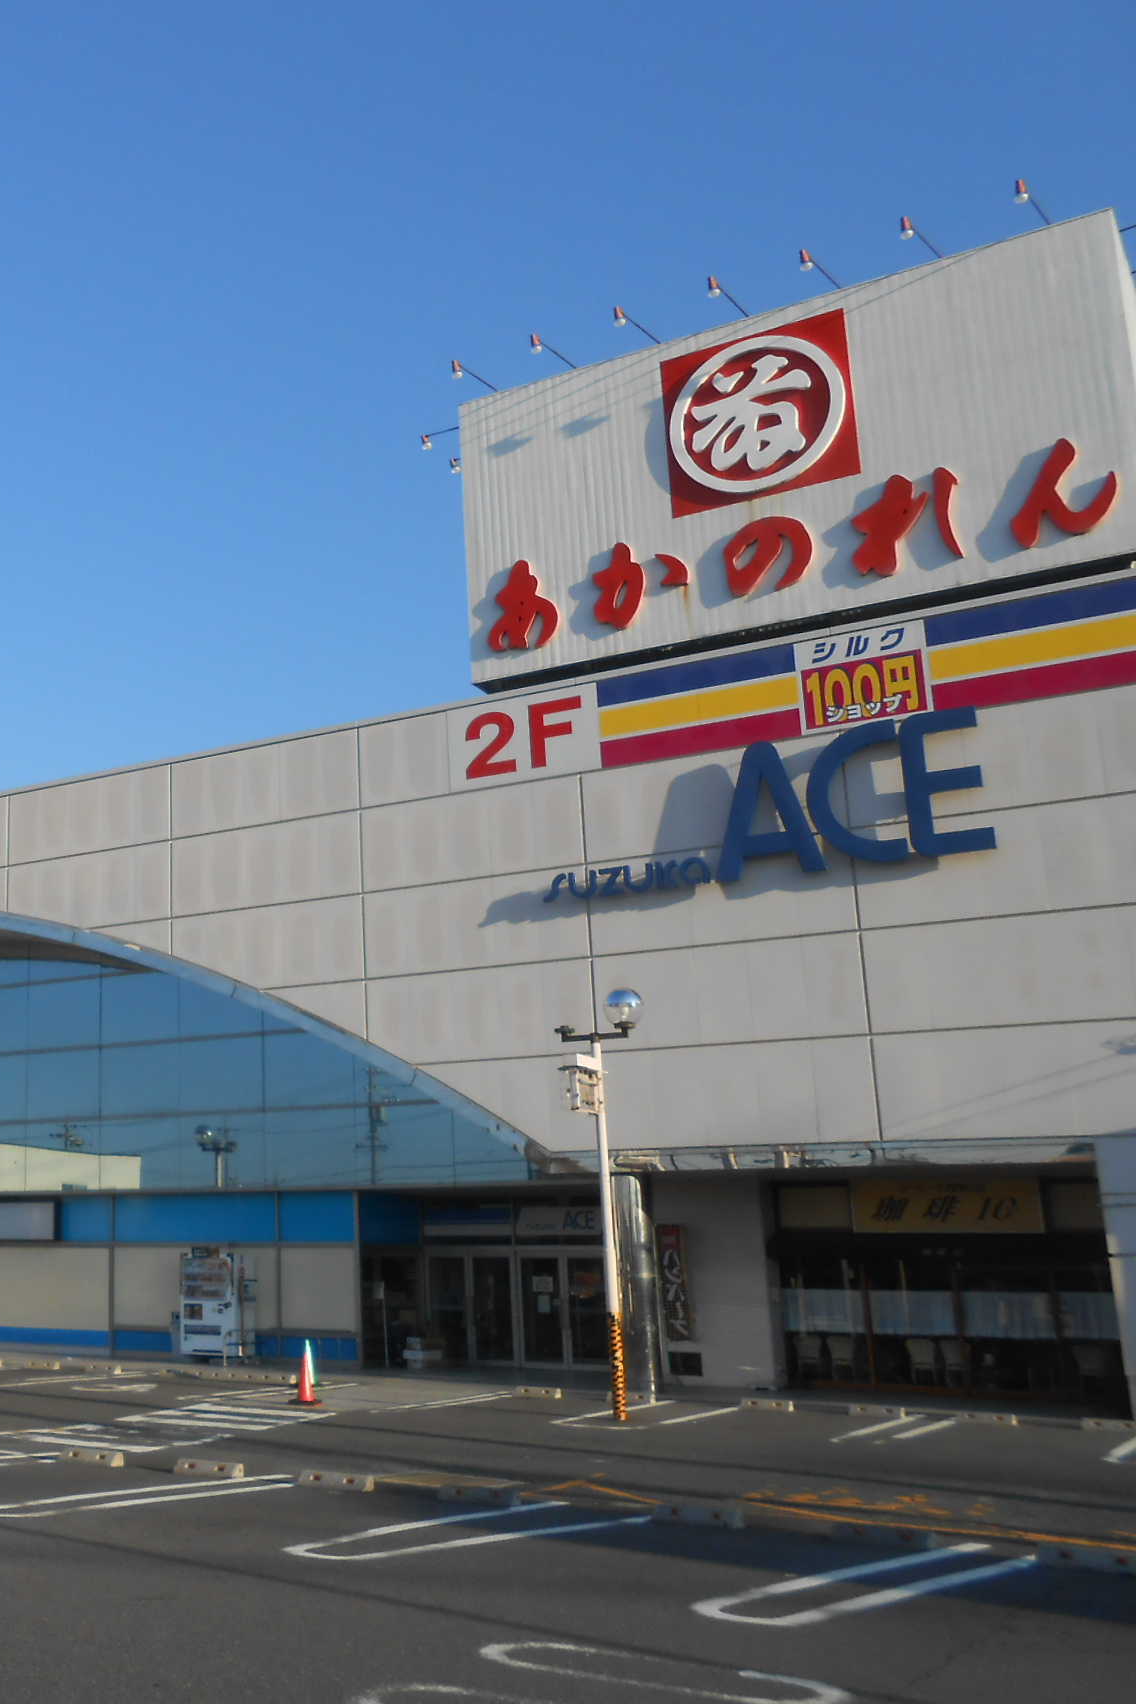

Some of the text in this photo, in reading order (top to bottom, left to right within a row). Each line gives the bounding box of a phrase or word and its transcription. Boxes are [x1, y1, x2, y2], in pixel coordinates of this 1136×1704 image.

[486, 438, 1118, 653] あかのれん
[812, 627, 905, 664] シルク
[806, 654, 919, 726] 100円
[825, 693, 903, 723] ショップ
[464, 694, 582, 781] 2F
[715, 705, 997, 884] ACE
[562, 1209, 595, 1230] ACE
